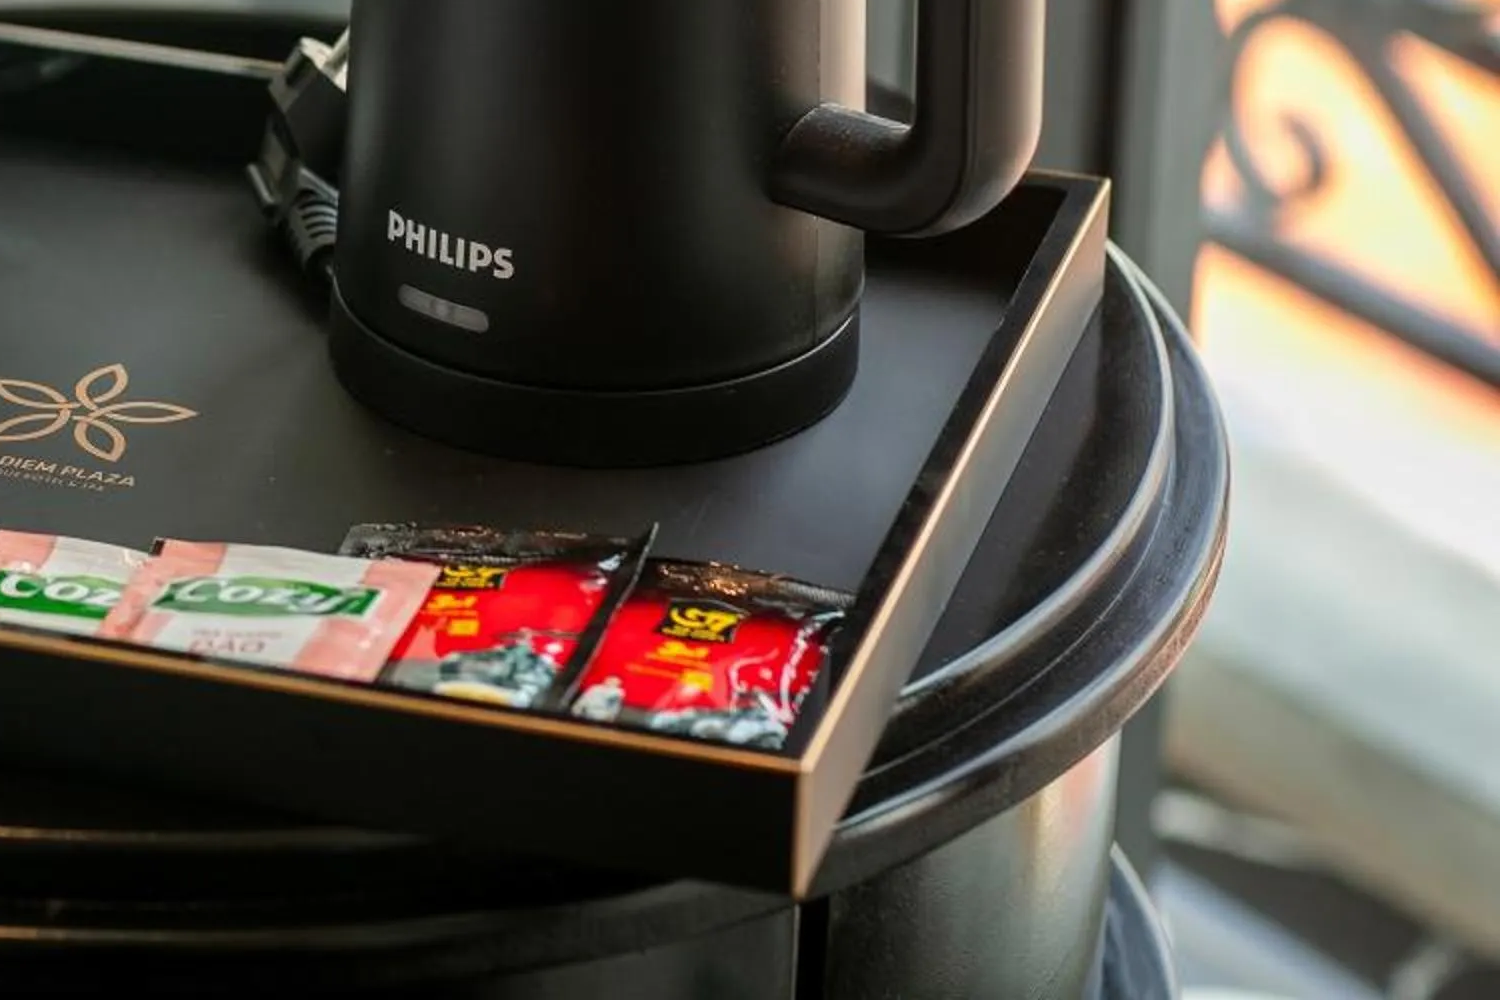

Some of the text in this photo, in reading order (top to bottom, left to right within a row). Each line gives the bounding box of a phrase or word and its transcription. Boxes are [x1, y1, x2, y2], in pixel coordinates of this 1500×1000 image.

[386, 208, 516, 279] PHILIPS
[0, 454, 55, 474] DIEM
[60, 464, 136, 487] PLAZA
[175, 577, 341, 613] Cozy
